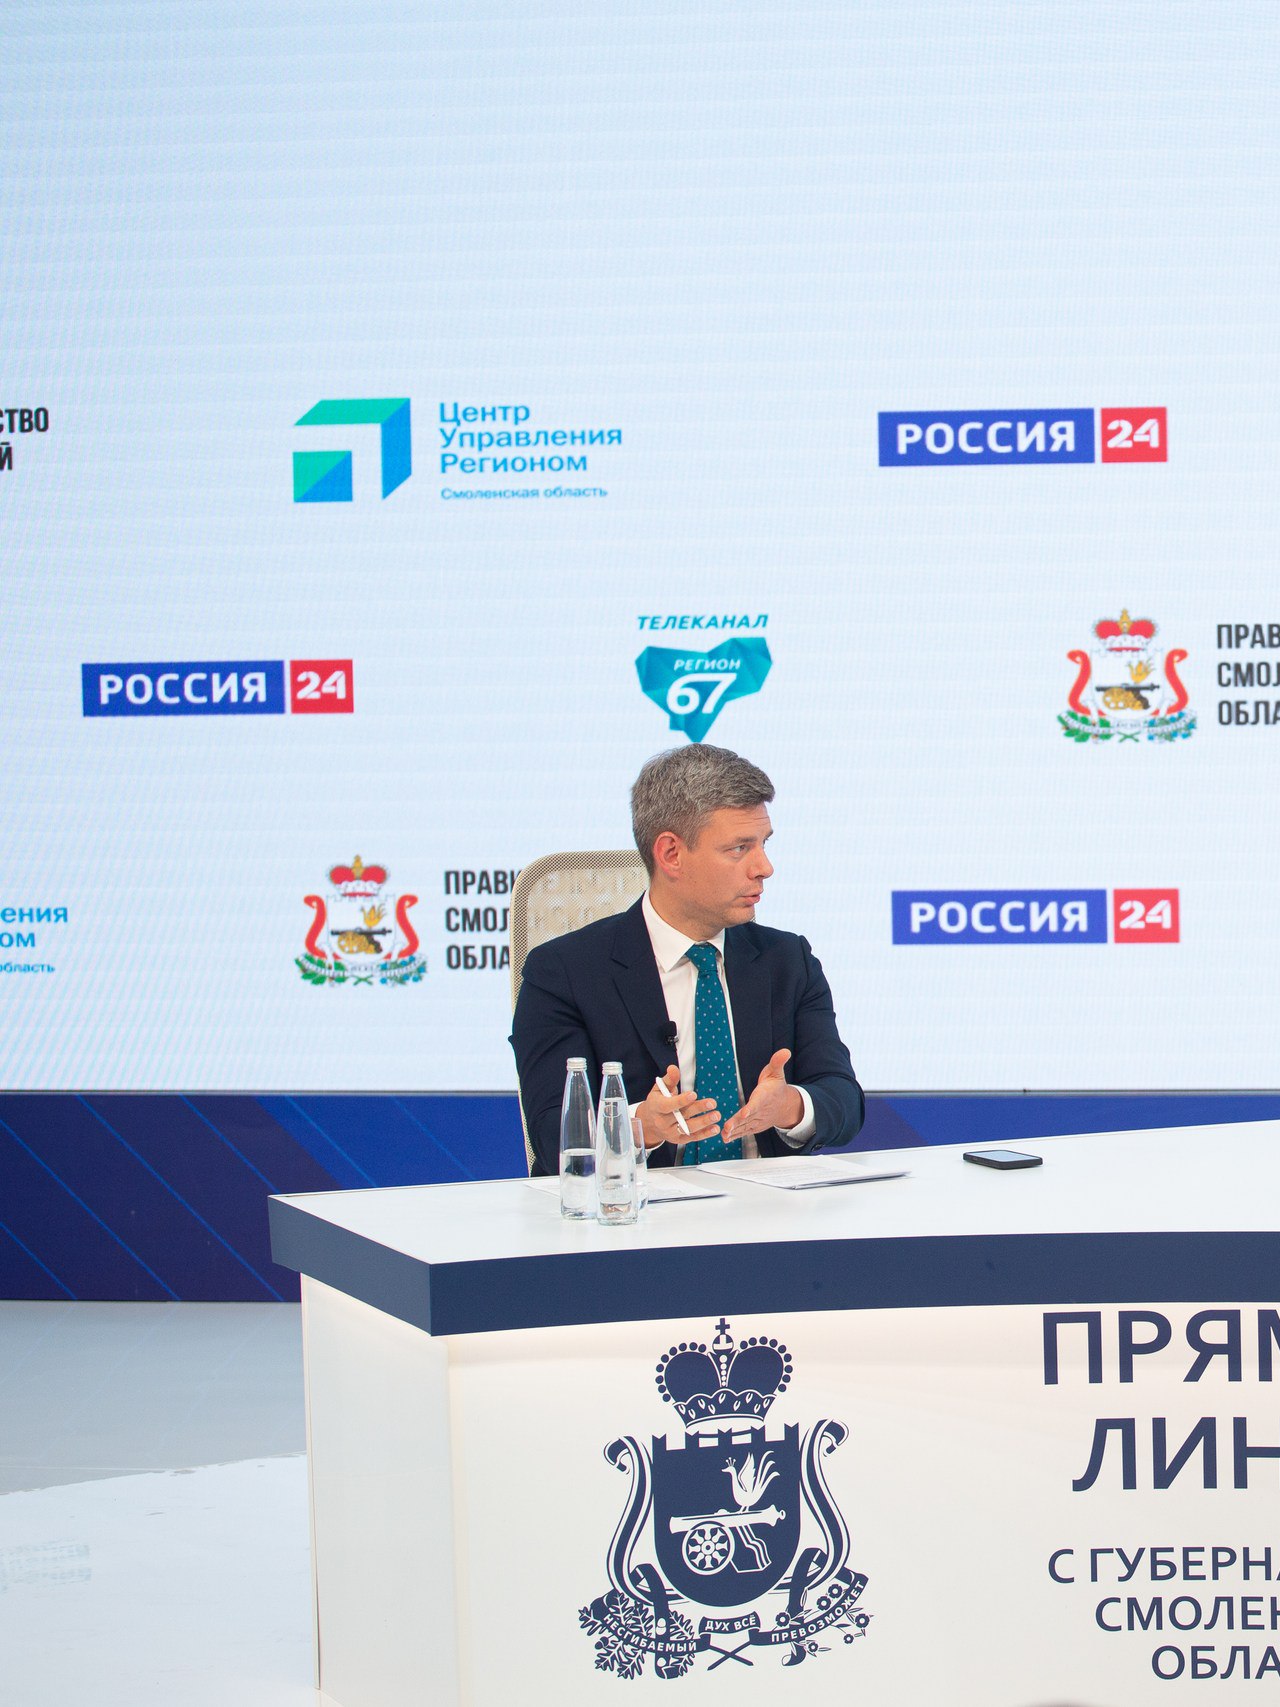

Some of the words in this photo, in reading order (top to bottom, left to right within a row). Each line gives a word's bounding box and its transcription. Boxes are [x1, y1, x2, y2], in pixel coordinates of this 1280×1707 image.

[0, 407, 49, 433] ТВО
[439, 402, 530, 426] Центр
[439, 427, 622, 452] Управления
[897, 420, 1075, 455] РОССИЯ
[1106, 418, 1159, 448] 24
[440, 453, 587, 473] Регионом
[441, 487, 539, 499] Смоленская
[543, 485, 608, 497] область
[637, 614, 769, 630] ТЕЛЕКАНАЛ
[674, 659, 741, 671] РЕГИОН
[100, 672, 266, 705] РОССИЯ
[296, 670, 346, 699] 24
[666, 672, 737, 715] 67
[911, 901, 1088, 933] РОССИЯ
[1119, 899, 1172, 930] 24
[1048, 1548, 1075, 1584] С
[603, 1613, 697, 1652] НЕСГИБАЕМЫЙ
[704, 1620, 730, 1632] ДУХ
[734, 1614, 756, 1630] ВСЁ
[771, 1581, 864, 1643] ПРЕВОЗМОЖЕТ
